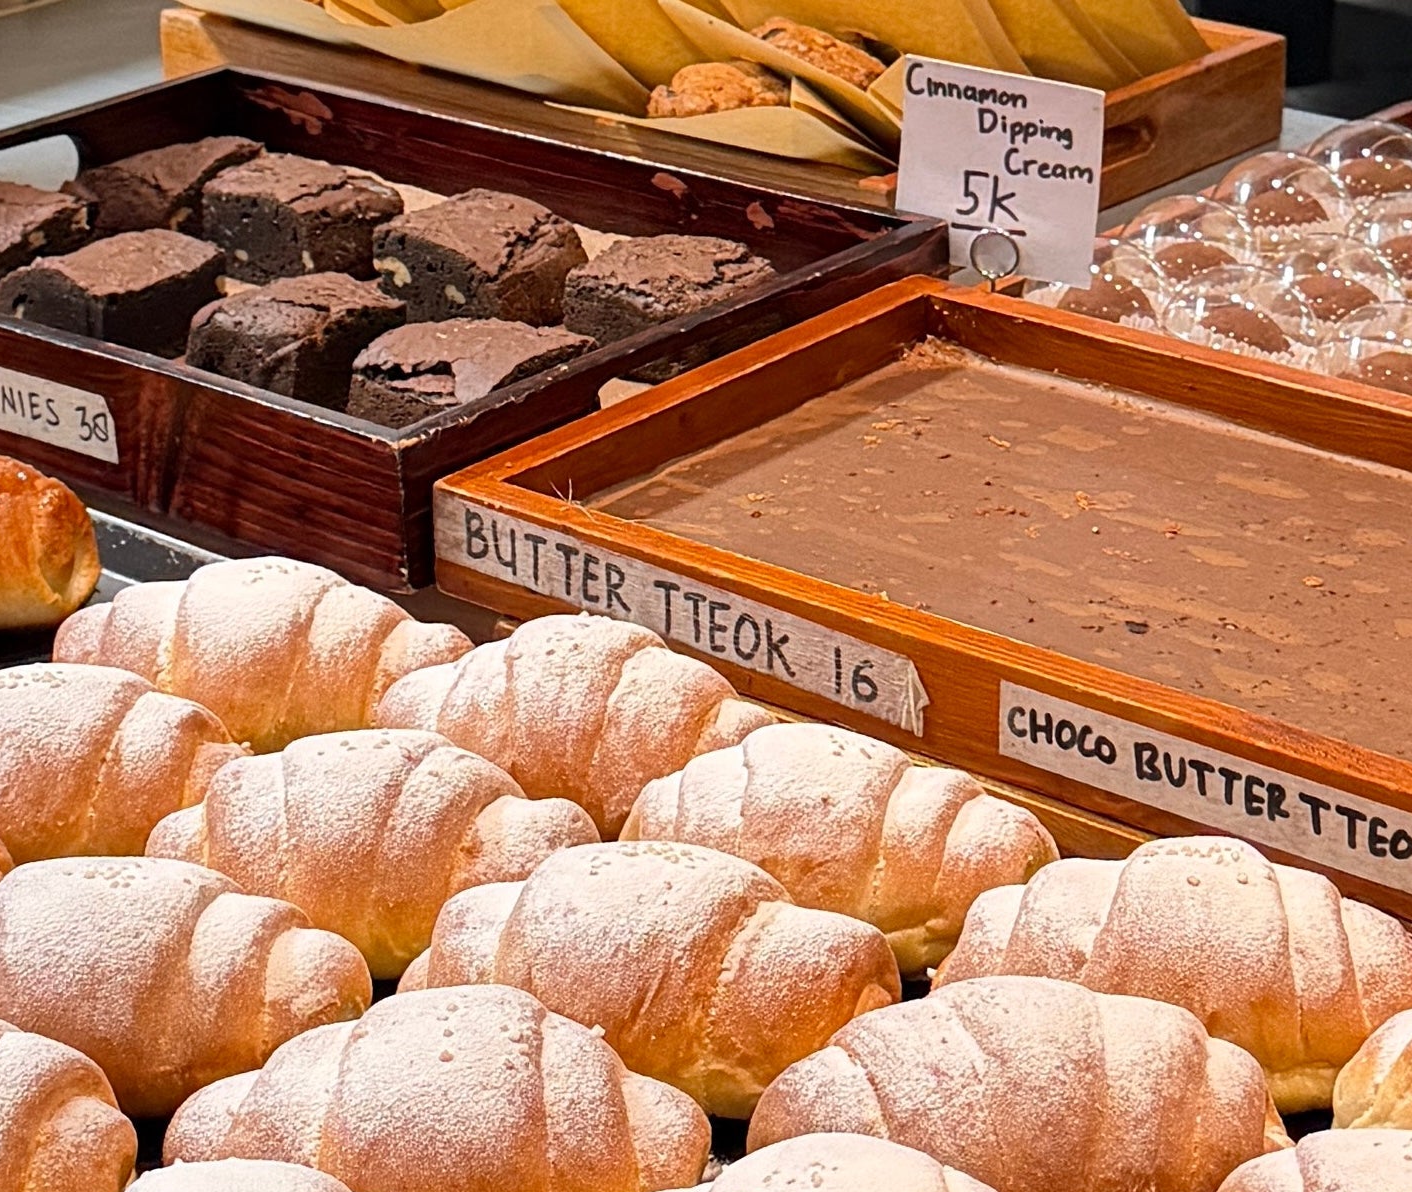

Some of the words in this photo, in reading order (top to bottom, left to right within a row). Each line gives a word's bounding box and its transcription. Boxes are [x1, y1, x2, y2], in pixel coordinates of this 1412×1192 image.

[977, 107, 1073, 150] Dipping
[1004, 147, 1094, 184] Cream
[463, 503, 632, 614] BUTTER
[654, 579, 797, 678] TTEOK
[832, 644, 880, 703] 16
[1007, 705, 1118, 765] CHOCO
[1134, 741, 1291, 822] BUTTER
